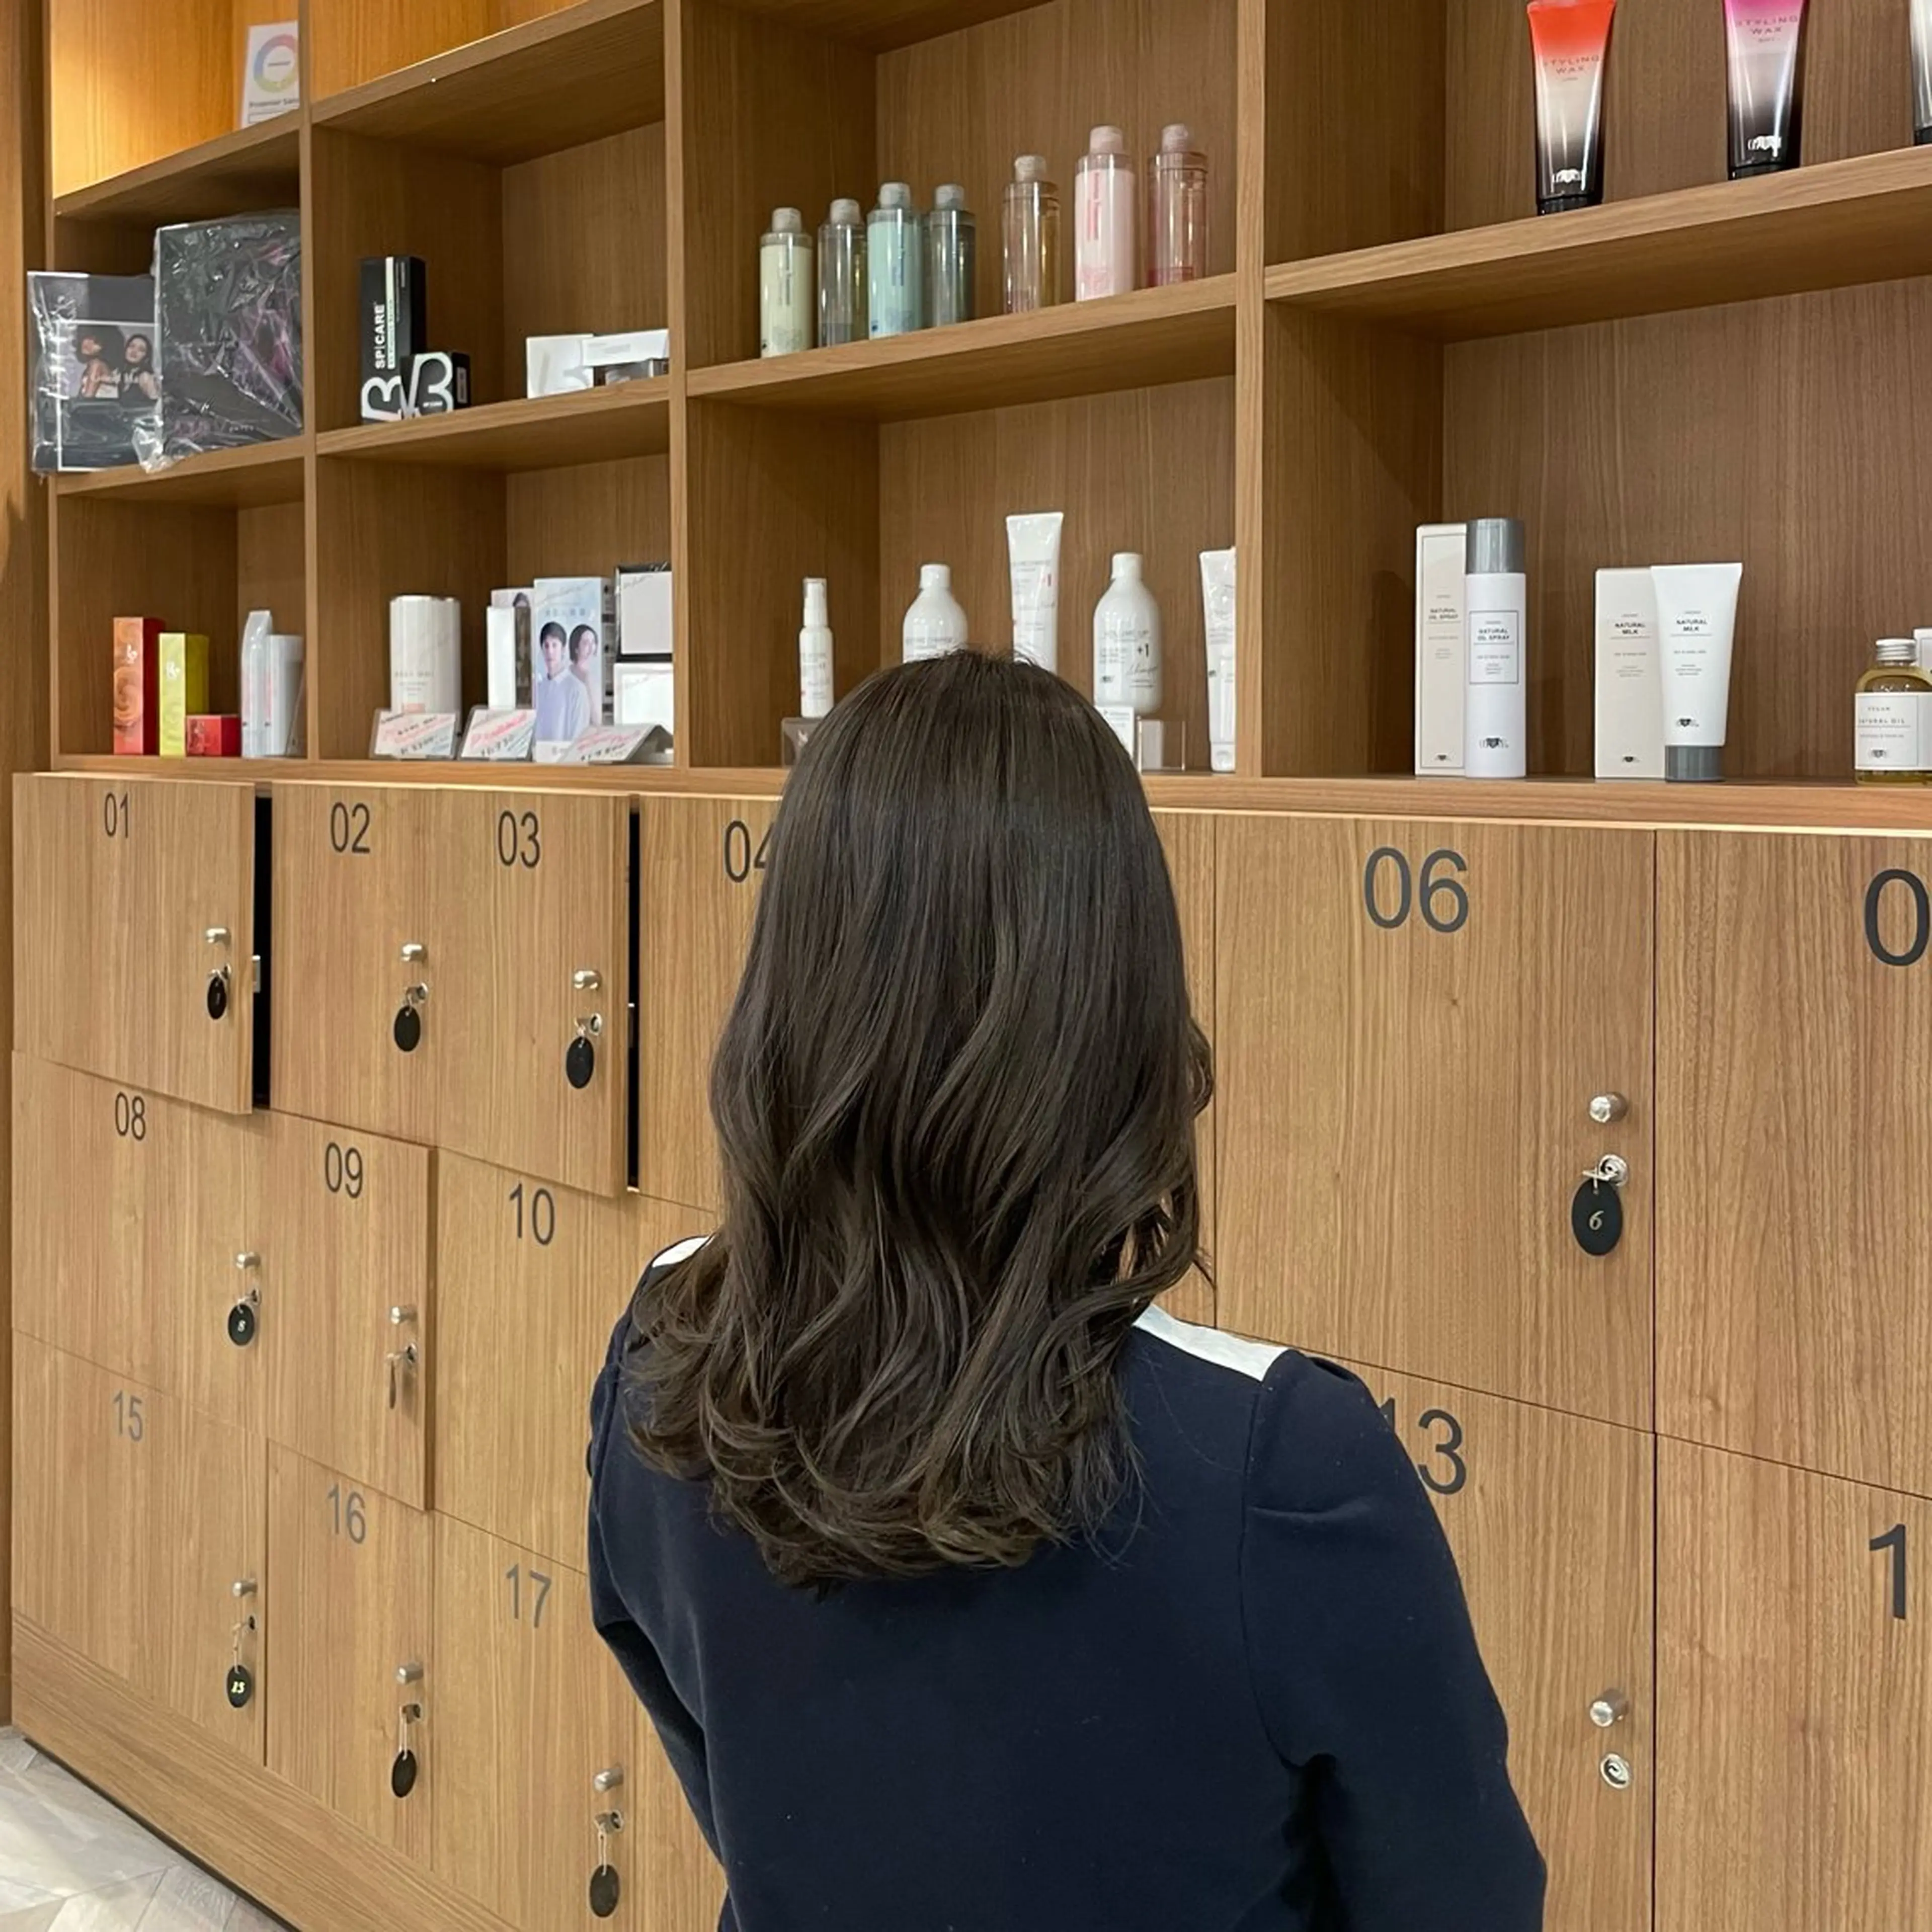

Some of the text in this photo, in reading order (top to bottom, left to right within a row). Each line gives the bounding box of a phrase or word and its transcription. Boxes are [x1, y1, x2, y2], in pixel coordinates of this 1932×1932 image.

[104, 791, 128, 839] 01
[330, 801, 371, 854] 02
[498, 810, 541, 868] 03
[1364, 847, 1469, 933] 06
[115, 1091, 146, 1141] 08
[325, 1142, 363, 1199] 09
[509, 1183, 554, 1246] 10
[1589, 1210, 1604, 1230] 6
[113, 1390, 143, 1441] 15
[327, 1484, 366, 1544] 16
[506, 1563, 552, 1628] 17
